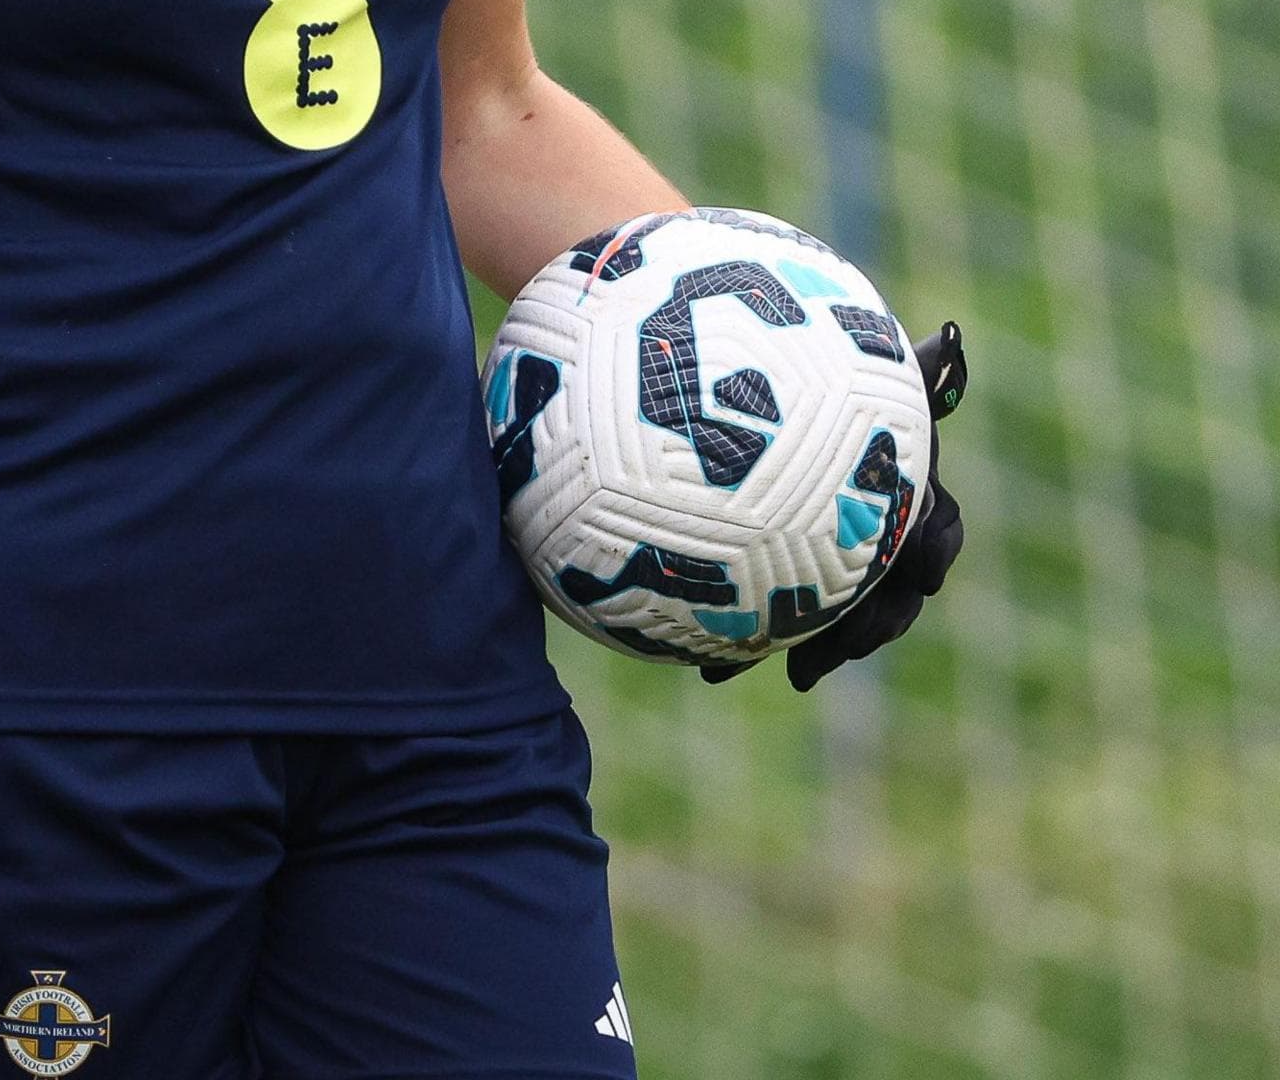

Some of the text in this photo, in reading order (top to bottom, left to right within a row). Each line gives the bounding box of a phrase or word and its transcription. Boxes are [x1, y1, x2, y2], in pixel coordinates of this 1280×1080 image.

[11, 991, 84, 1018] IRISH FOOTBALL
[3, 1022, 95, 1037] NORTHERN IRELAND
[12, 1048, 82, 1073] ASSOCIATION
